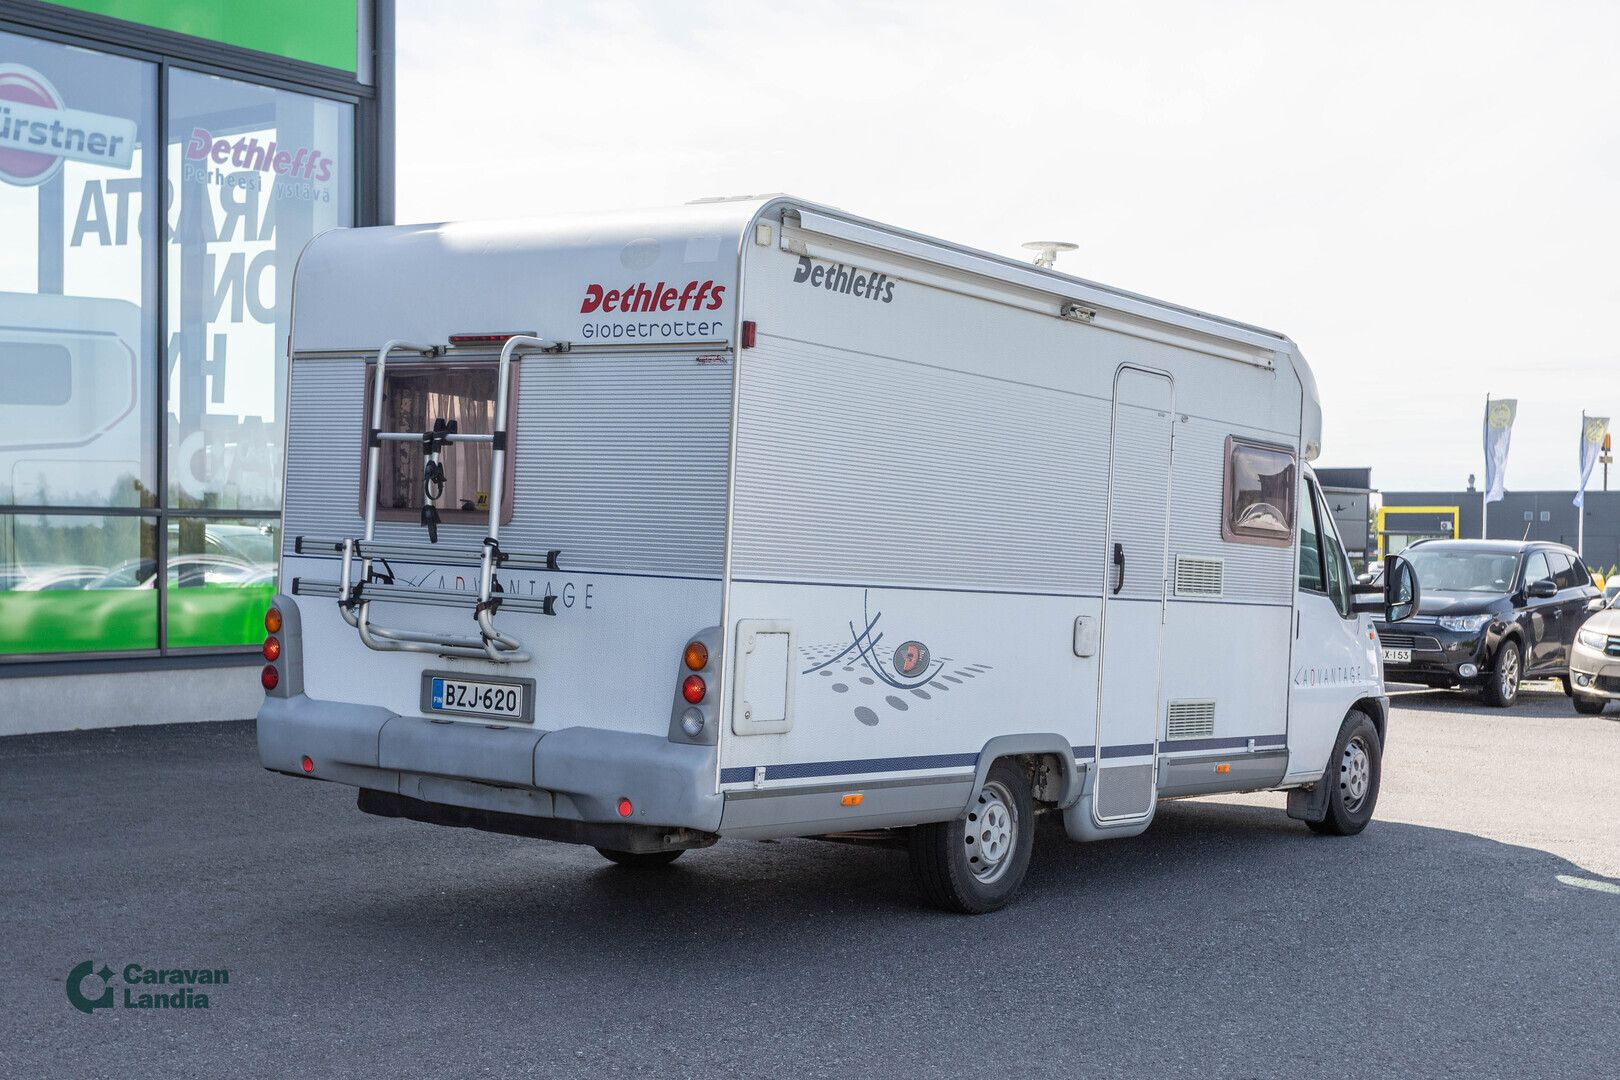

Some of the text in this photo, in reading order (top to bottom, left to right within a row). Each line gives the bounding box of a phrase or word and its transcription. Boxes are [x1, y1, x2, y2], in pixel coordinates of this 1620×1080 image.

[186, 127, 333, 182] Dethleffs
[184, 163, 262, 192] Perheesi
[793, 255, 895, 304] Dethleffs
[580, 280, 726, 314] Dethleffs
[582, 321, 723, 339] Globetrotter
[438, 575, 594, 610] ADNTAGE
[1382, 650, 1409, 660] X-153
[1303, 665, 1361, 687] ADVANTAGE
[433, 696, 443, 704] FIN
[446, 684, 517, 712] BZJ-620
